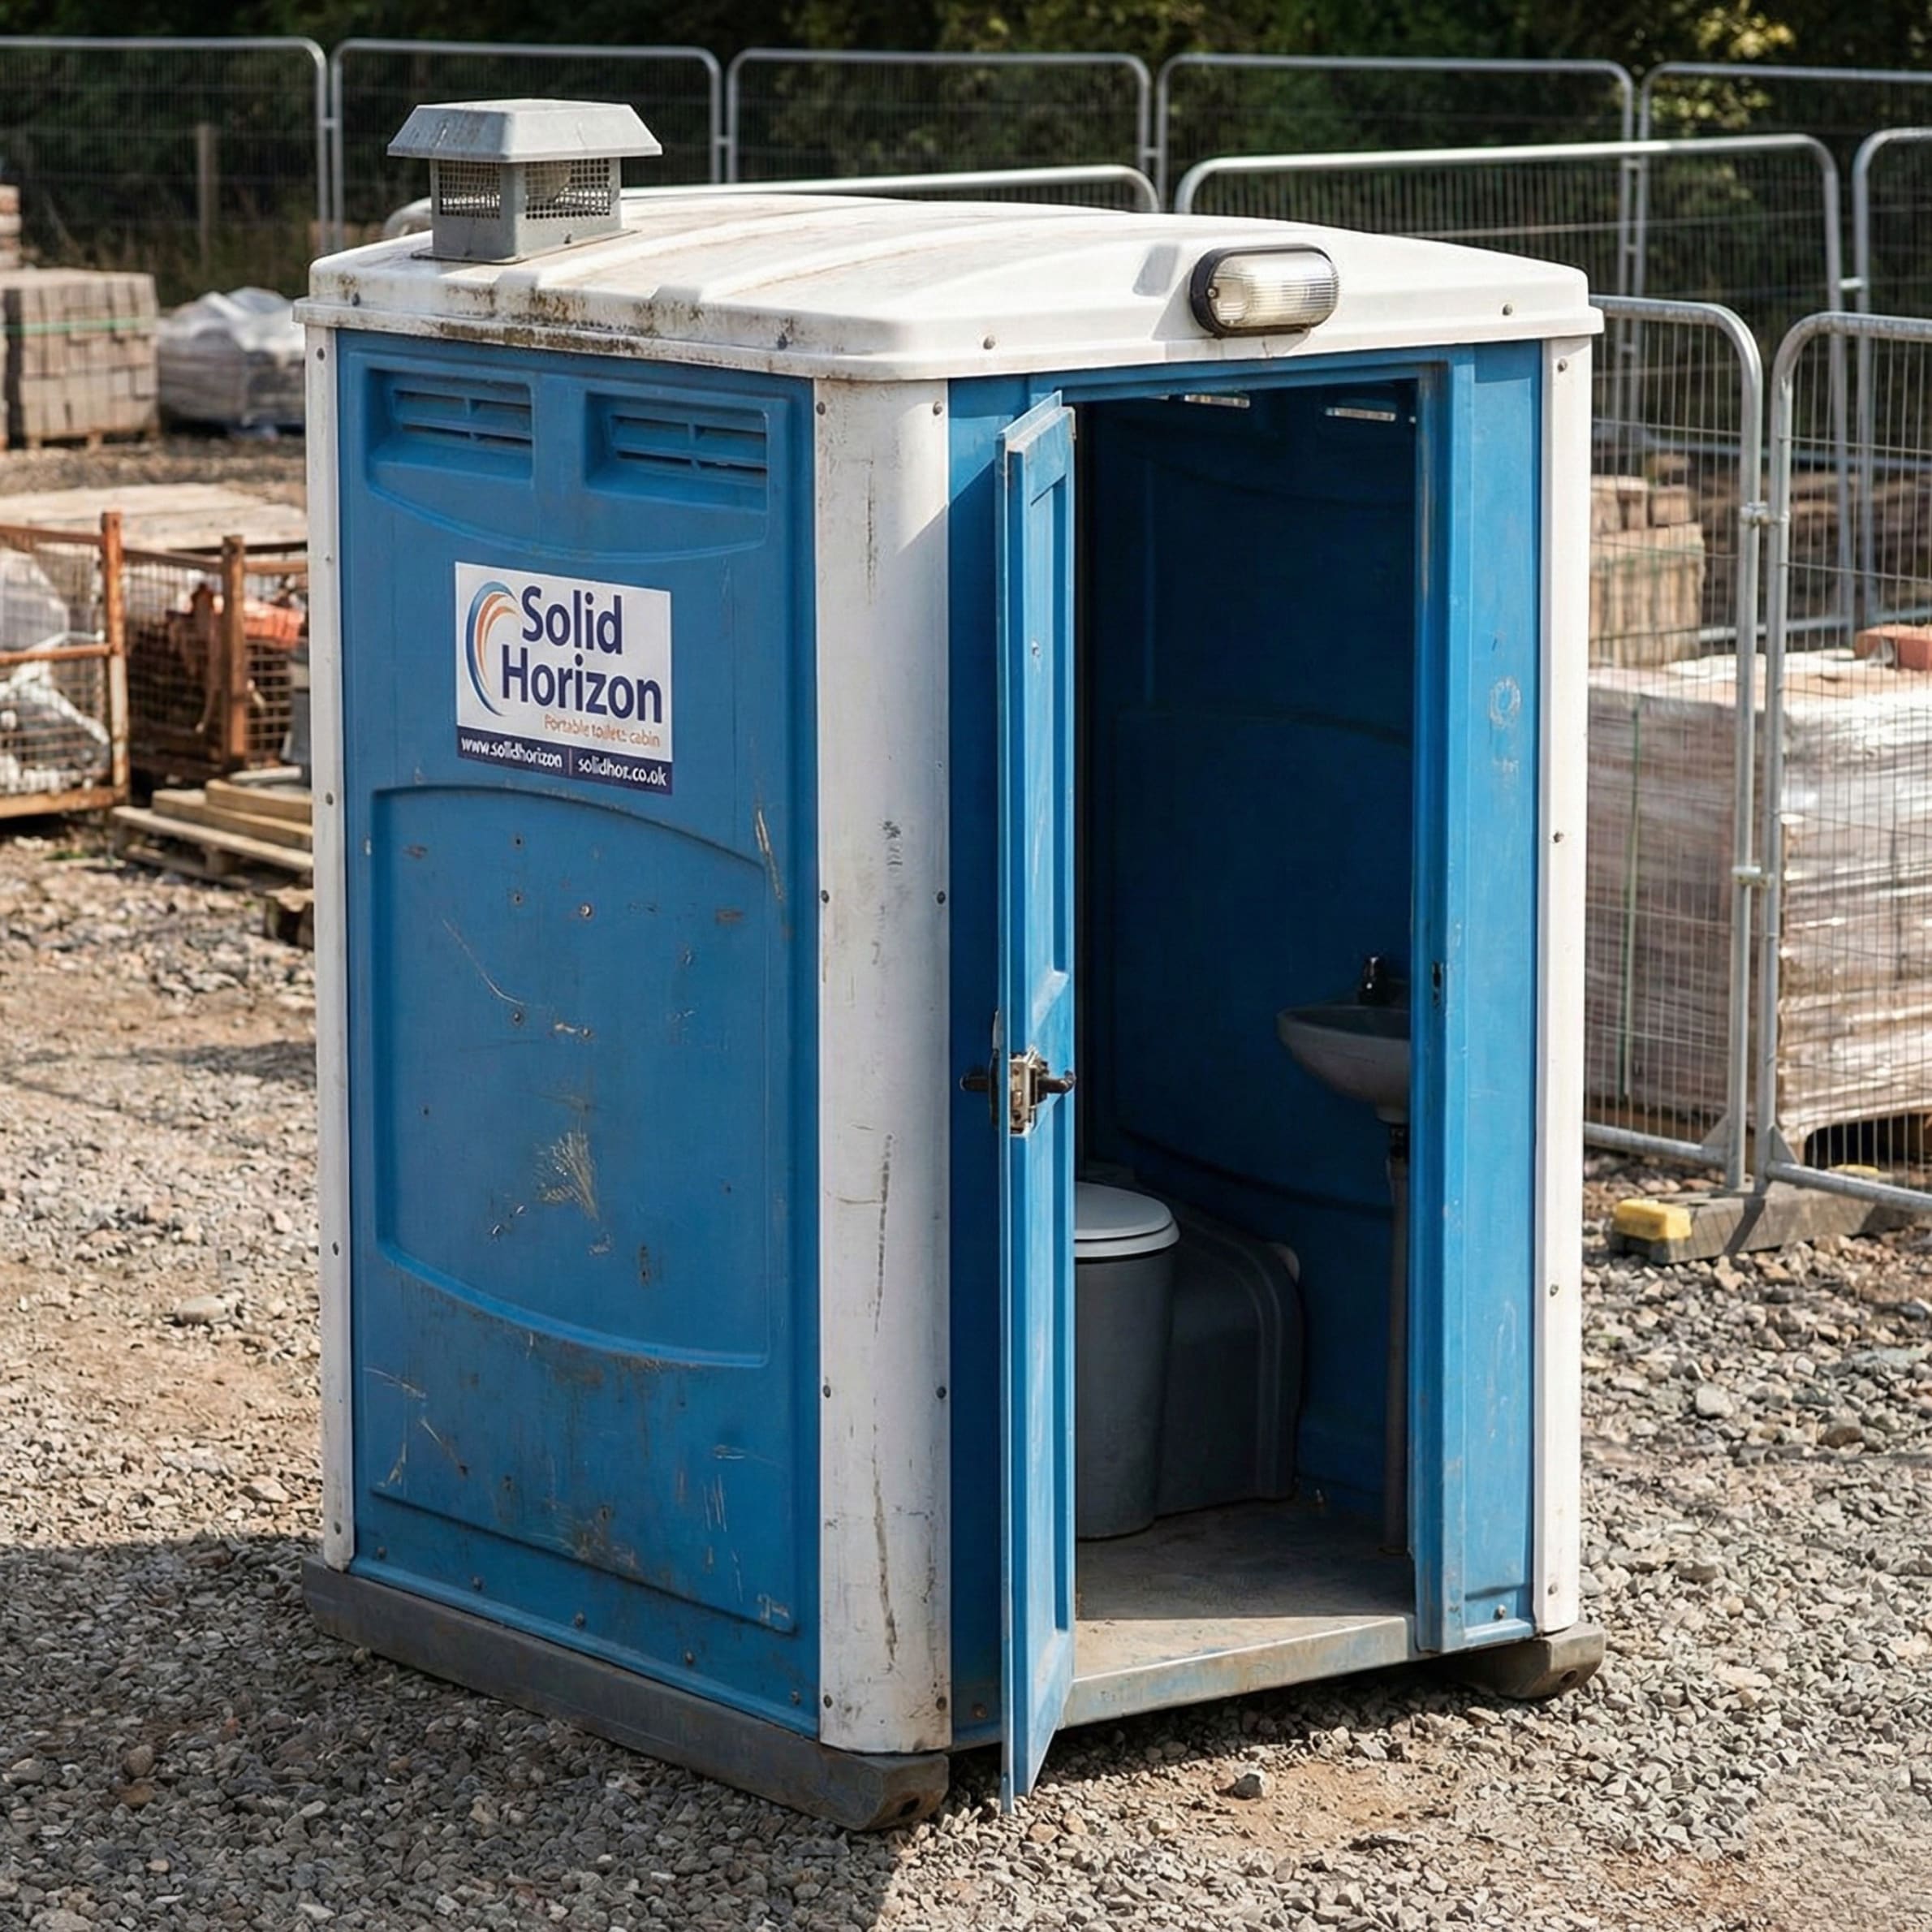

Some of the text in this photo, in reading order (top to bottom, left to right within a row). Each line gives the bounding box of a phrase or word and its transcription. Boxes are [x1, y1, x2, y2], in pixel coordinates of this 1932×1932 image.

[521, 585, 623, 655] Solid
[501, 644, 662, 724] Horizon
[629, 730, 660, 748] cabin
